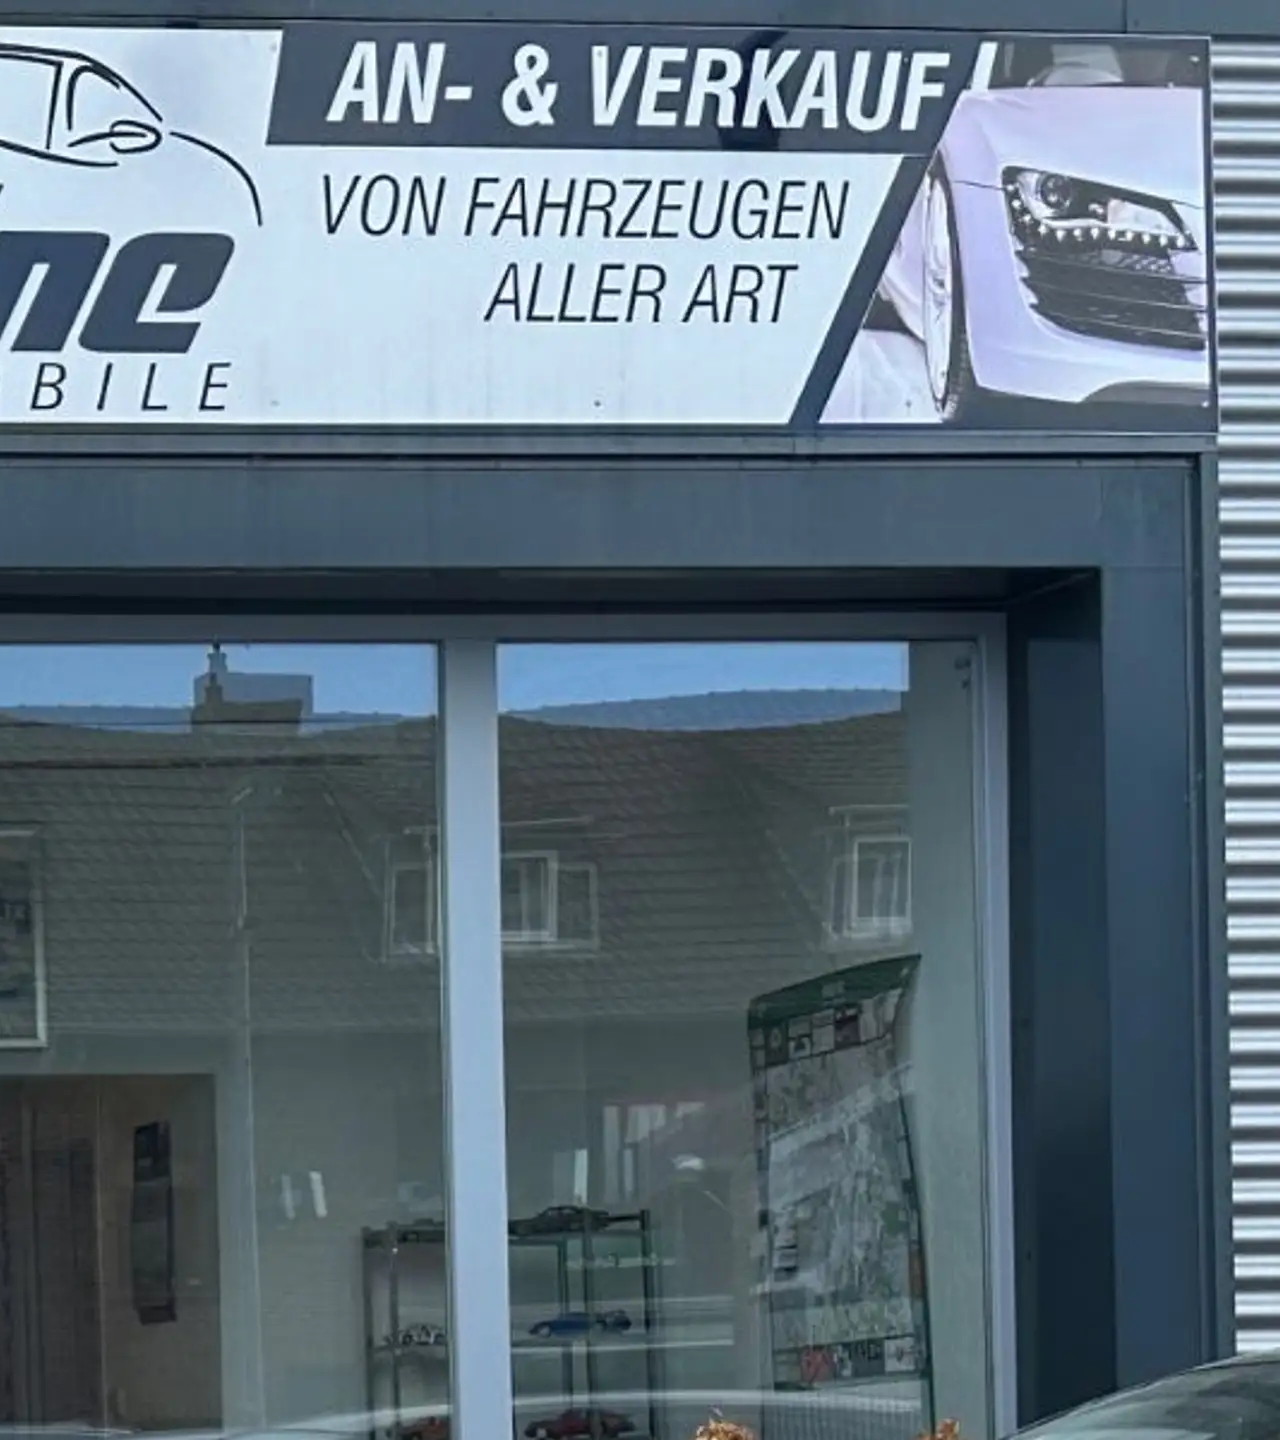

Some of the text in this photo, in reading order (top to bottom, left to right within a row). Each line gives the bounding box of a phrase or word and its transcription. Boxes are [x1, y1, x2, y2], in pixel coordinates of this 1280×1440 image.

[324, 40, 473, 123] AN-
[500, 43, 559, 126] &
[322, 174, 850, 240] VON FAHRZEUGEN
[482, 262, 800, 324] ALLER ART
